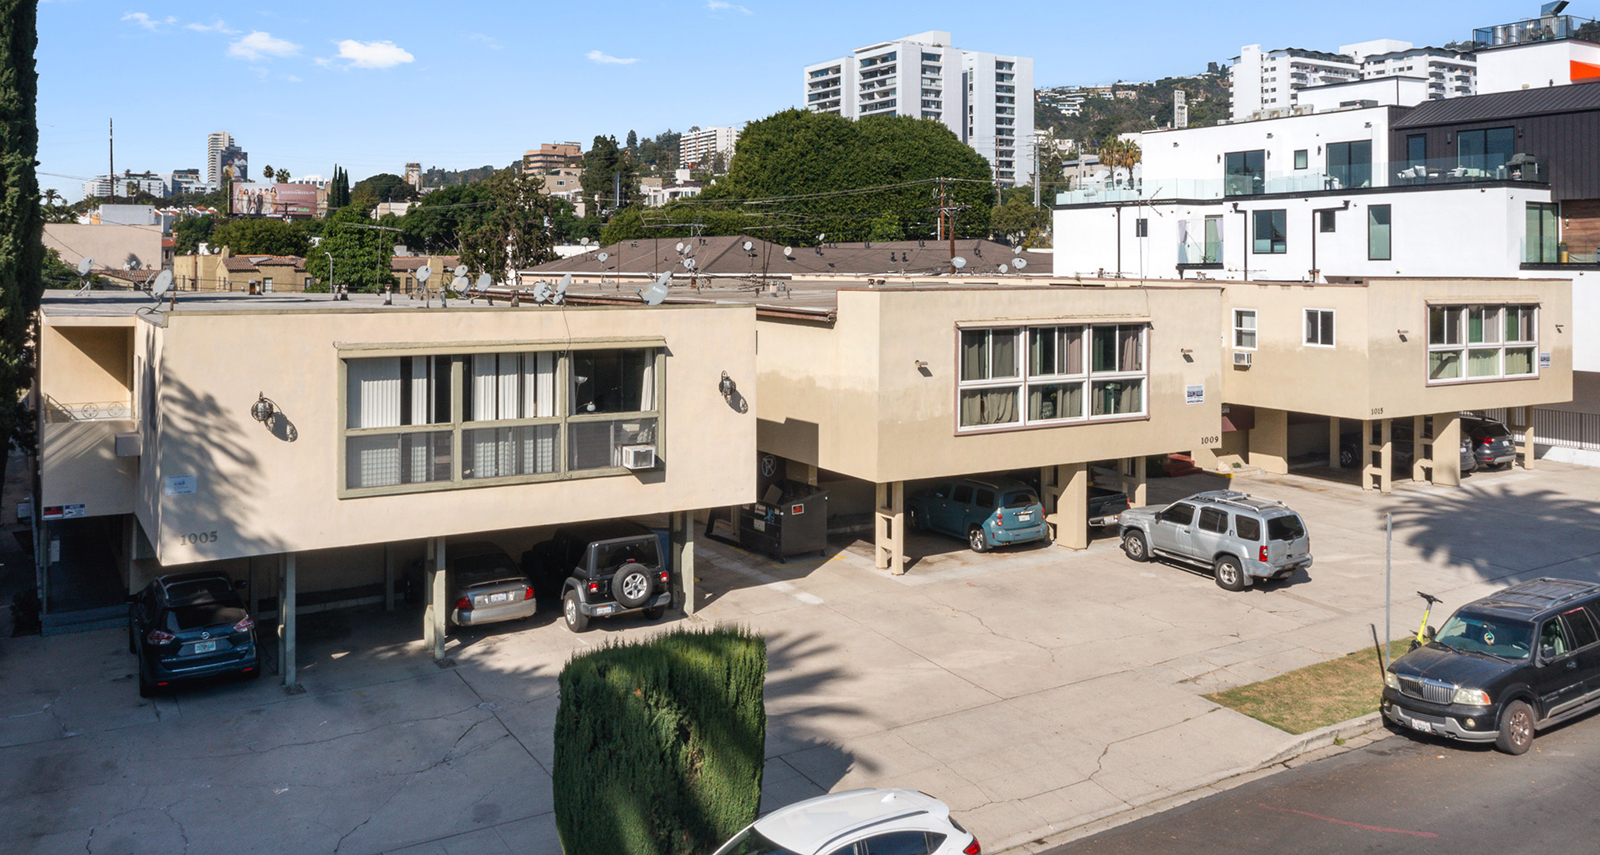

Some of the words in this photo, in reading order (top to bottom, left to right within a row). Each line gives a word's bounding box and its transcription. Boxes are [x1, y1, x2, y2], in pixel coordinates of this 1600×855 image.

[1371, 407, 1384, 415] 1015
[1201, 436, 1219, 445] 1009
[181, 531, 218, 546] 1005
